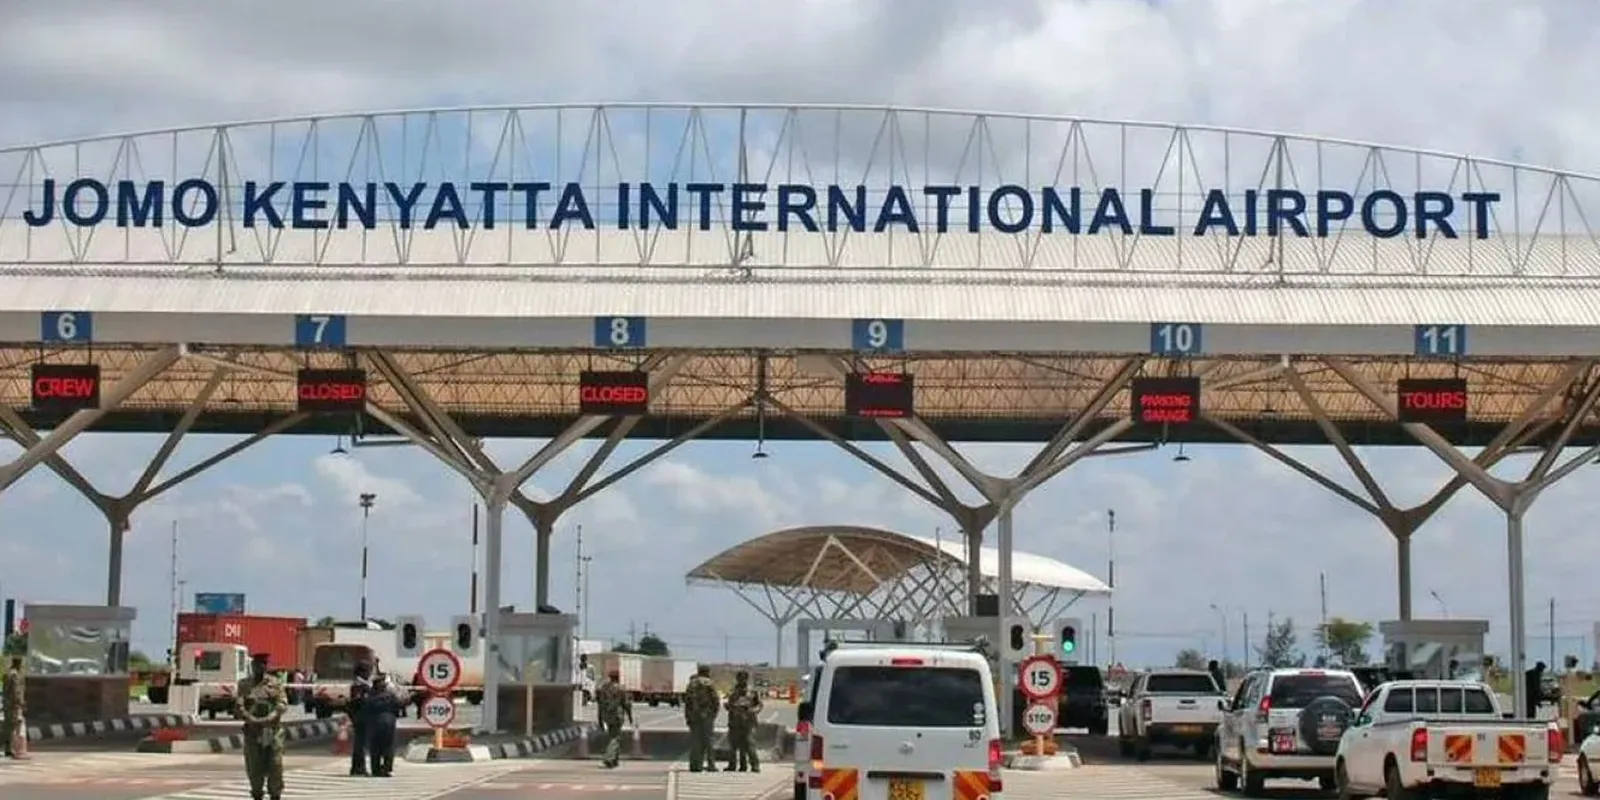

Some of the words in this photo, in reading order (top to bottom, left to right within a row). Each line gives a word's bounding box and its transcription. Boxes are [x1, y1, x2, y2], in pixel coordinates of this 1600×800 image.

[24, 178, 218, 228] JOMO
[242, 181, 594, 231] KENYATTA
[617, 182, 1174, 236] INTERNATIONAL
[1194, 189, 1500, 240] AIRPORT
[56, 314, 75, 339] 6
[311, 316, 331, 343] 7
[610, 319, 629, 345] 8
[867, 321, 888, 349] 9
[1159, 325, 1193, 352] 10
[1423, 327, 1458, 353] 11
[35, 378, 94, 397] CREW
[299, 384, 364, 400] CLOSED
[581, 386, 647, 403] CLOSED
[1141, 395, 1191, 407] PARKING
[1402, 392, 1465, 409] TOURS
[429, 663, 449, 680] 15
[1030, 670, 1051, 687] 15
[427, 706, 451, 716] STOP
[1028, 713, 1053, 724] STOP
